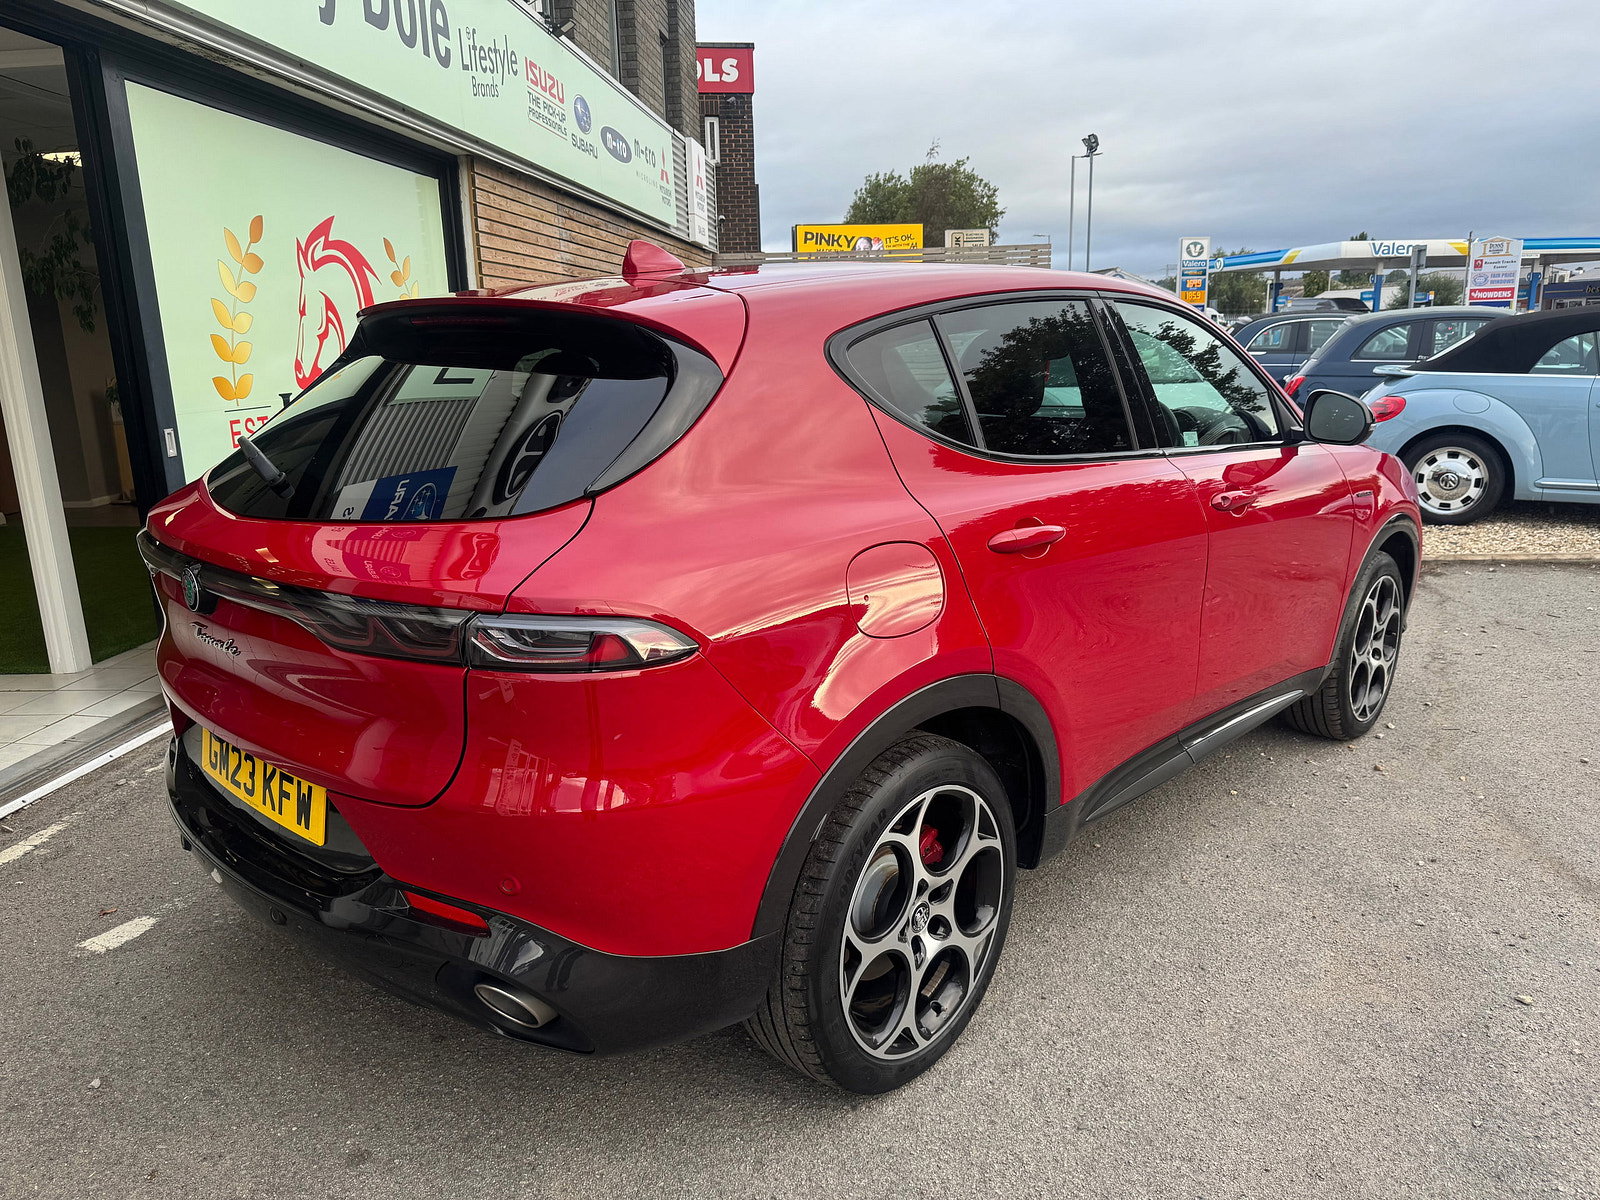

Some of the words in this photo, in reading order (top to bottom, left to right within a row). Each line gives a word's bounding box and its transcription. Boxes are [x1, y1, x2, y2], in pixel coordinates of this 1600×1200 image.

[458, 26, 518, 86] Lifestyle
[472, 76, 499, 97] Brands
[524, 56, 565, 104] ISUZU
[527, 90, 541, 110] THE
[543, 100, 566, 124] PICK-UP
[528, 106, 568, 137] PROFESSIONALS
[571, 133, 598, 159] SUBARU
[803, 231, 855, 248] PINKY
[1371, 242, 1414, 255] Valer
[1477, 290, 1512, 299] HOWDENS
[209, 732, 256, 798] GM23
[262, 761, 313, 831] KFW
